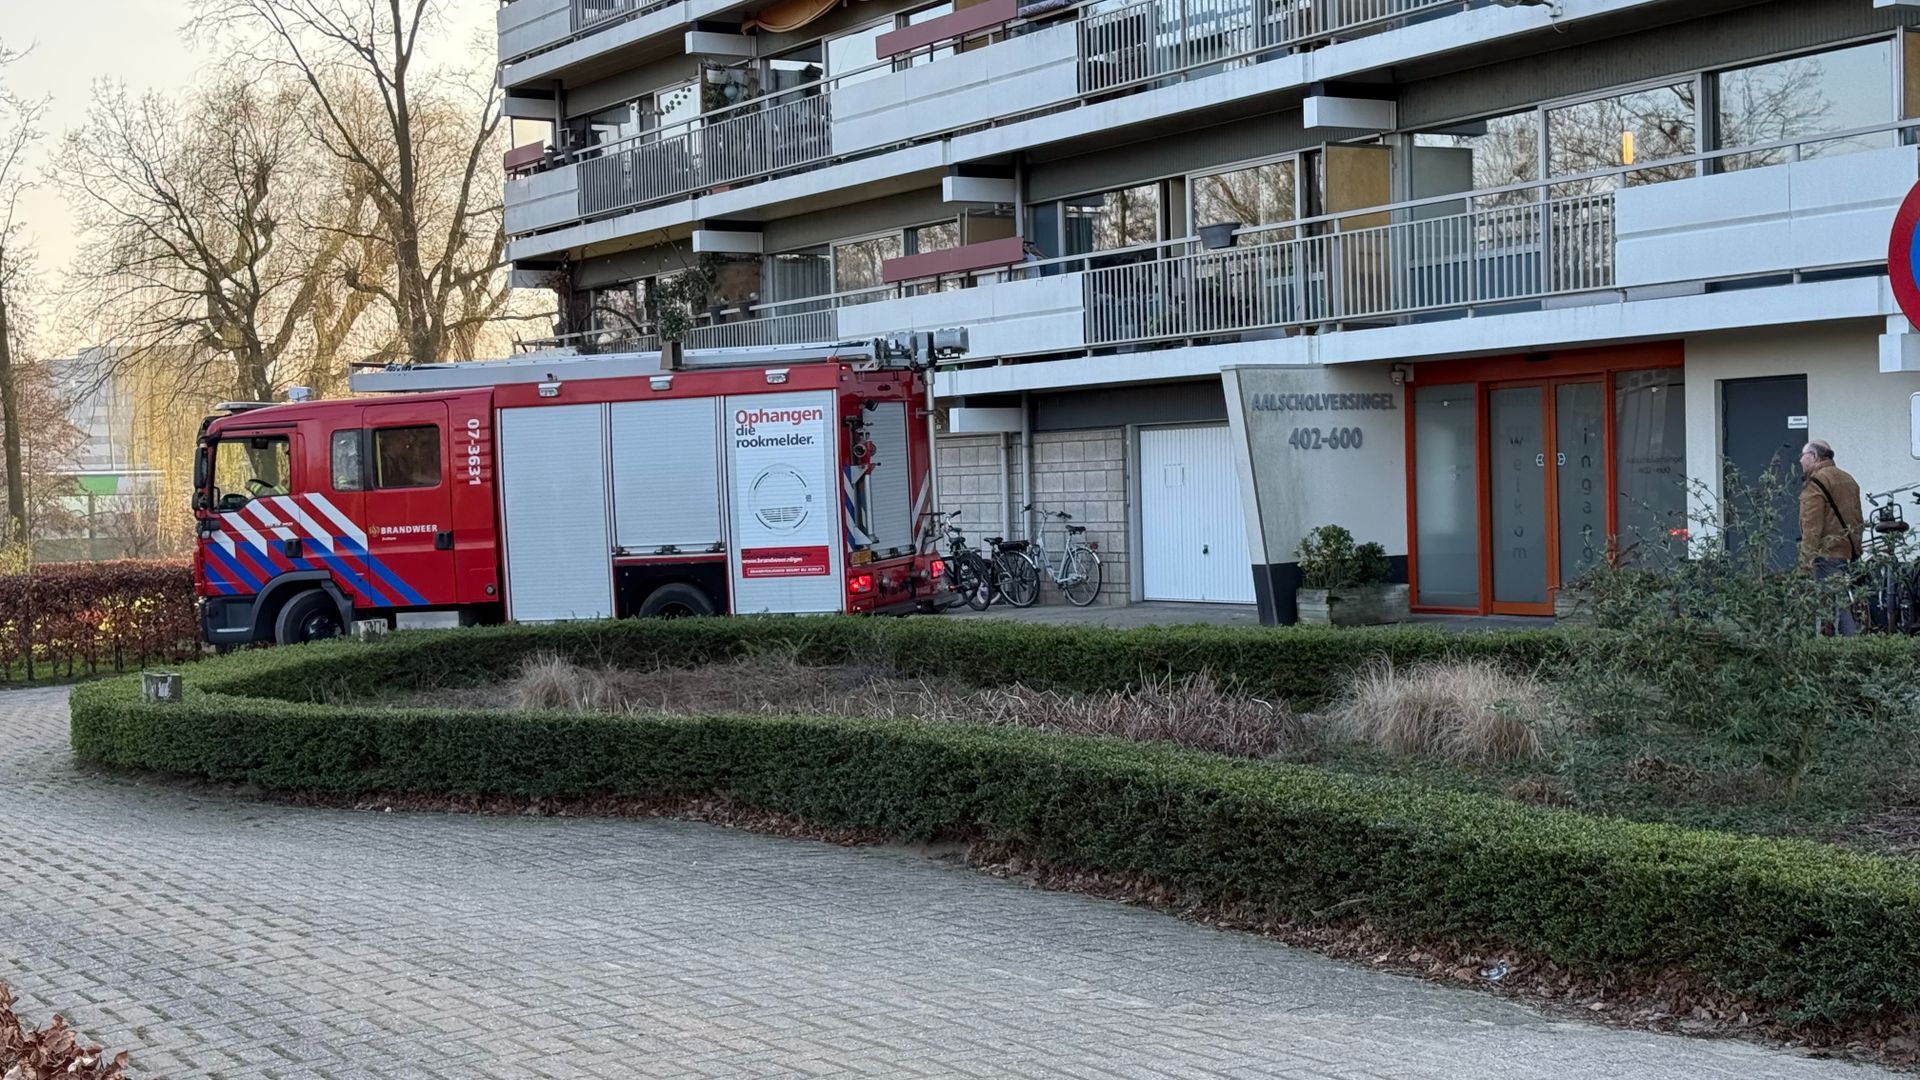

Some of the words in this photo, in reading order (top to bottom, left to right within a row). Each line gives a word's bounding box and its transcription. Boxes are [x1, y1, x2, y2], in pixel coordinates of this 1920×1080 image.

[1253, 393, 1397, 411] AALSCHOLVERSINGEL
[736, 407, 823, 426] Ophangen
[736, 425, 756, 436] die
[1289, 427, 1363, 450] 402-600
[736, 434, 815, 448] rookmelder.
[467, 418, 482, 485] 07-3631
[380, 525, 438, 535] BRANDWEER
